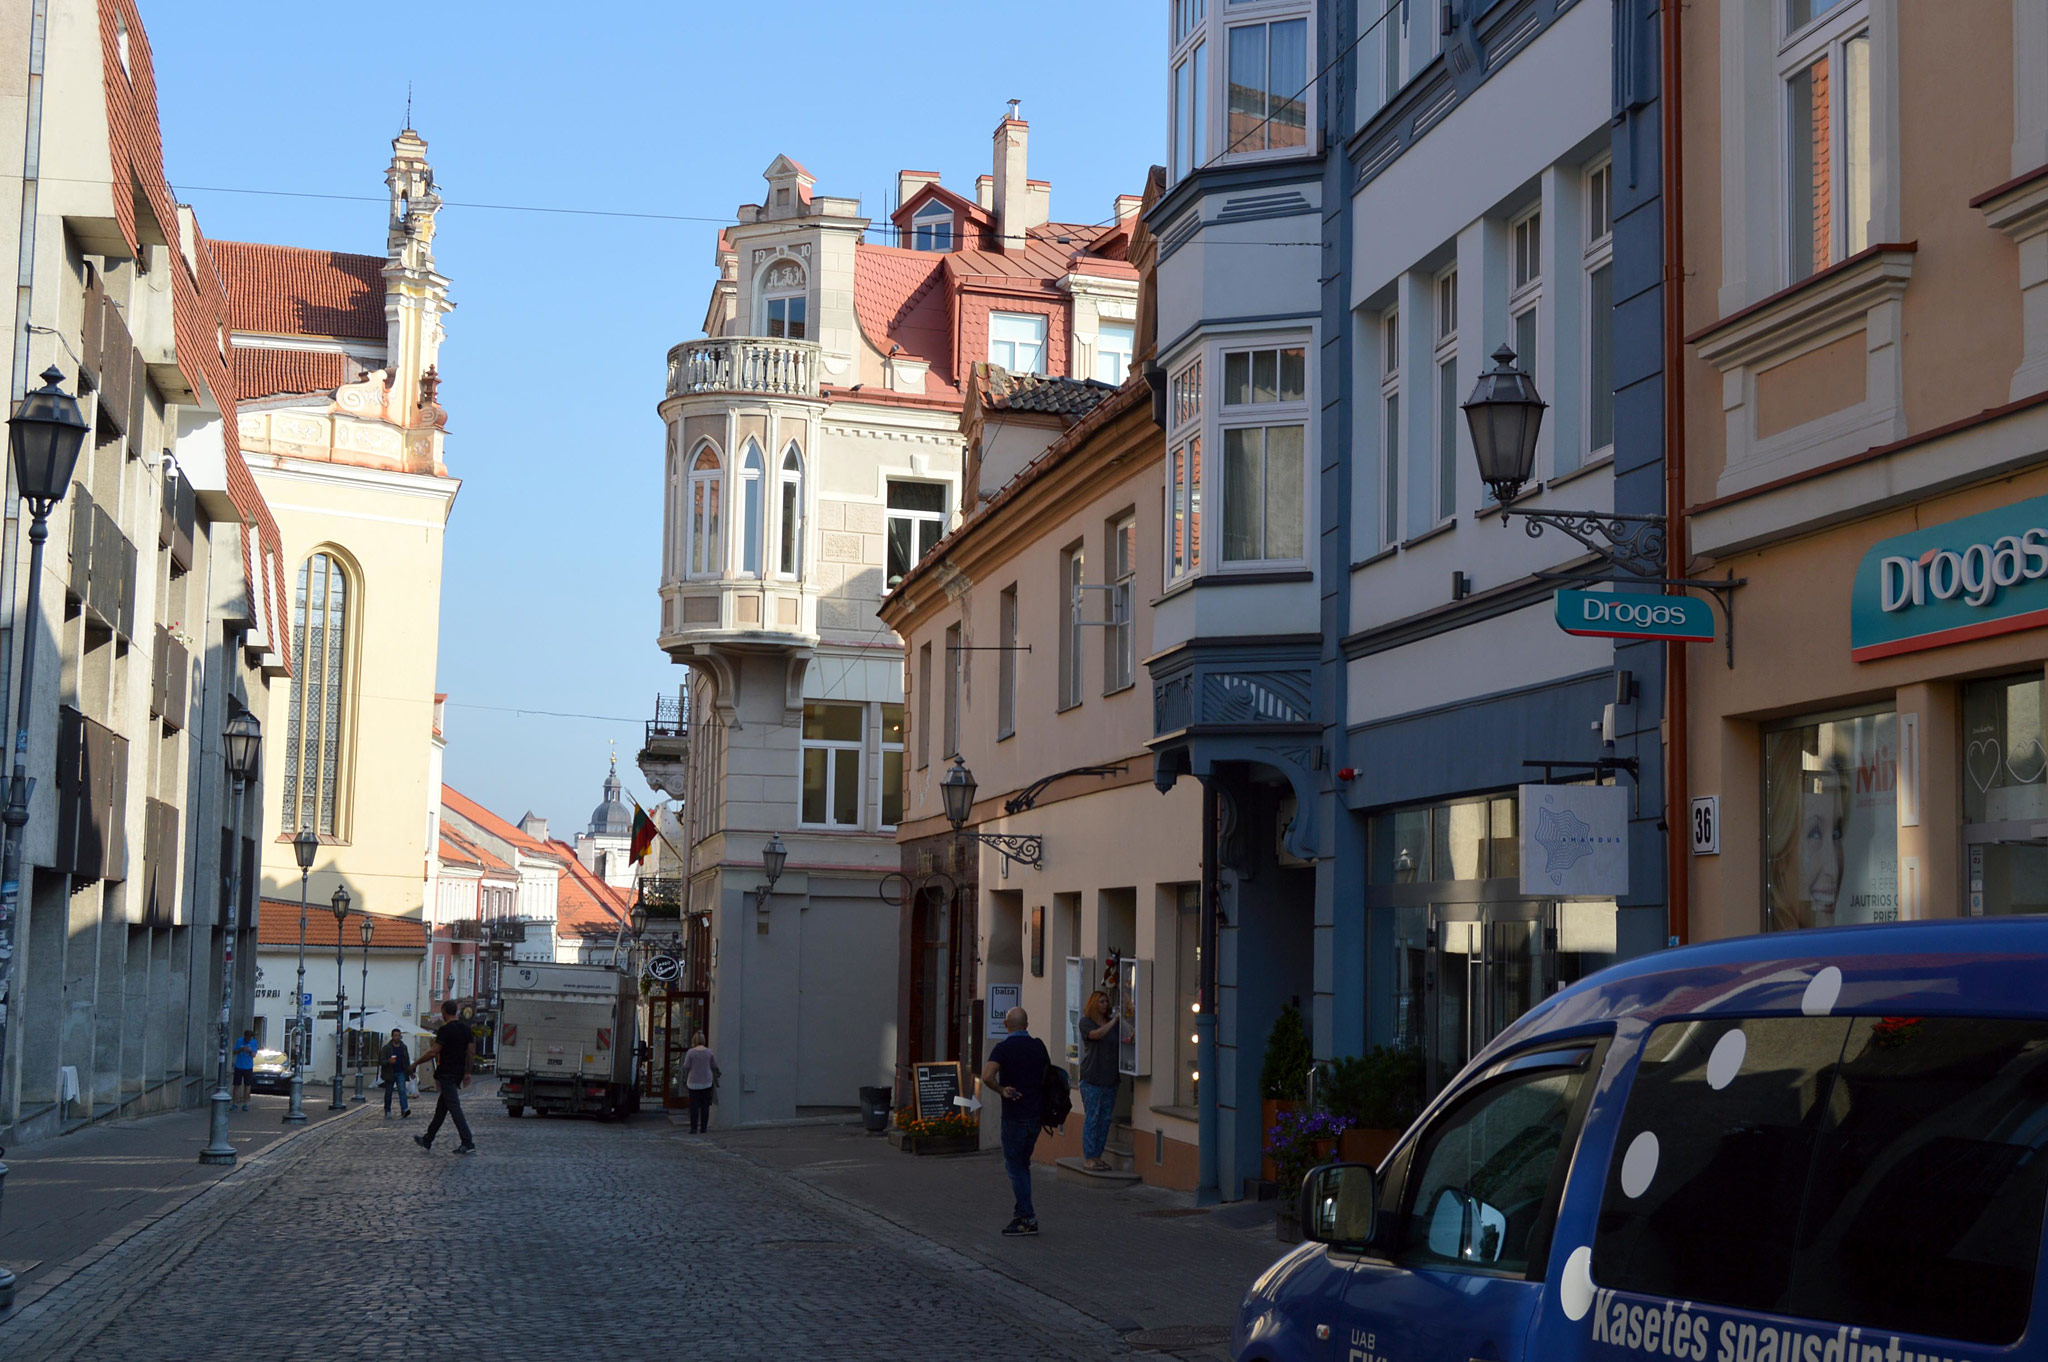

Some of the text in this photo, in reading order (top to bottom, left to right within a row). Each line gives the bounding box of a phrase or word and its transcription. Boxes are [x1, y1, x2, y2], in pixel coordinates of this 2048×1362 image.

[1881, 527, 2048, 612] Drogas
[1584, 598, 1686, 628] Drogas
[1695, 807, 1712, 844] 36
[1561, 836, 1621, 844] AMANDUS
[1879, 877, 1897, 890] EFE
[1850, 894, 1892, 908] JAUTRIOS
[1592, 1288, 1710, 1362] Kasetės
[1351, 1328, 1376, 1350] UAB
